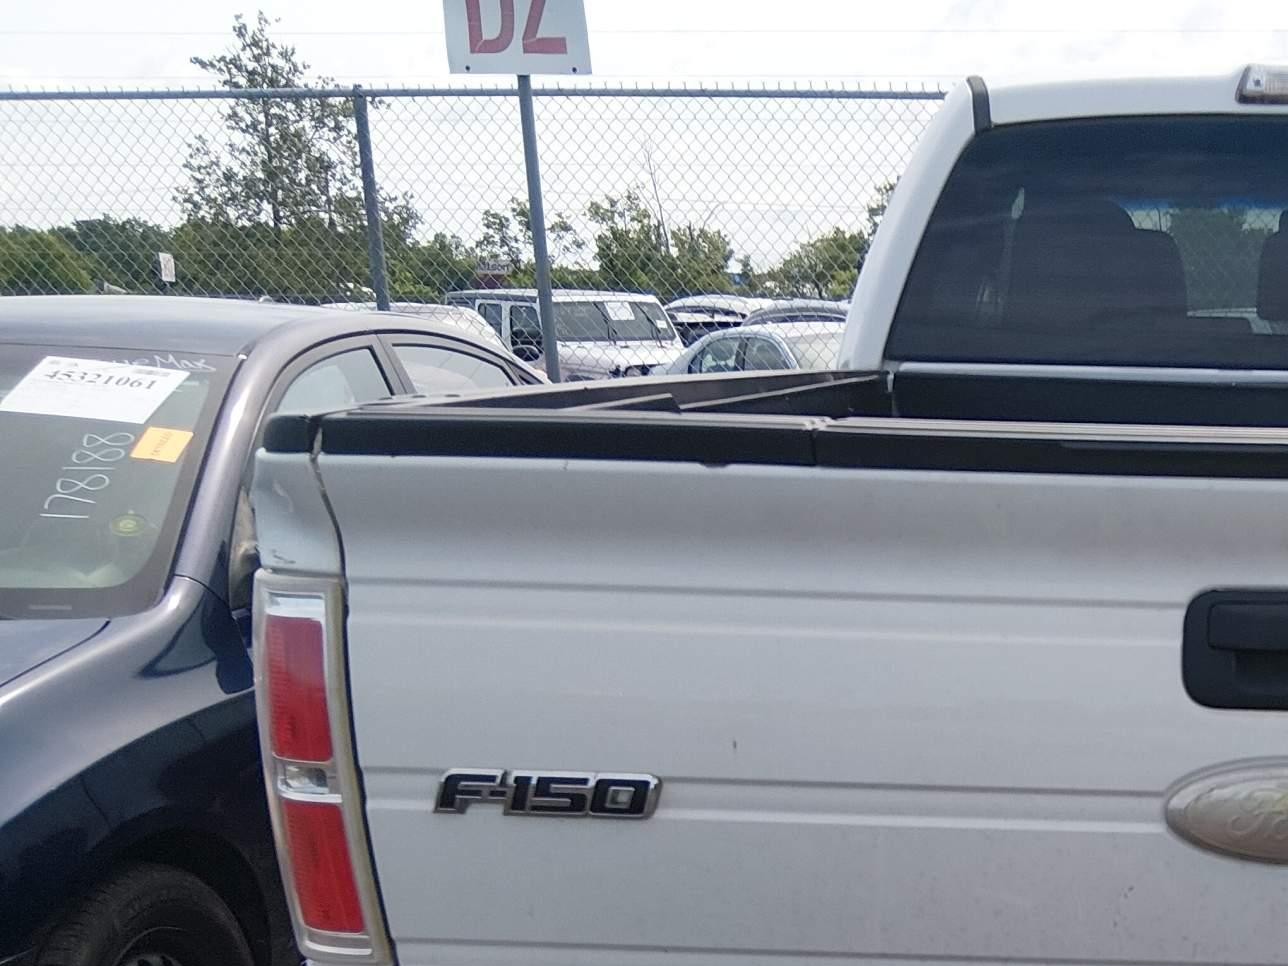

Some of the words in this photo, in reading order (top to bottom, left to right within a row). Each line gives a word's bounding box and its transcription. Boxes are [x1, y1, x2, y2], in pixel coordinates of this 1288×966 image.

[45, 369, 158, 390] 45321061
[40, 431, 135, 519] 178188
[434, 768, 663, 819] F-150
